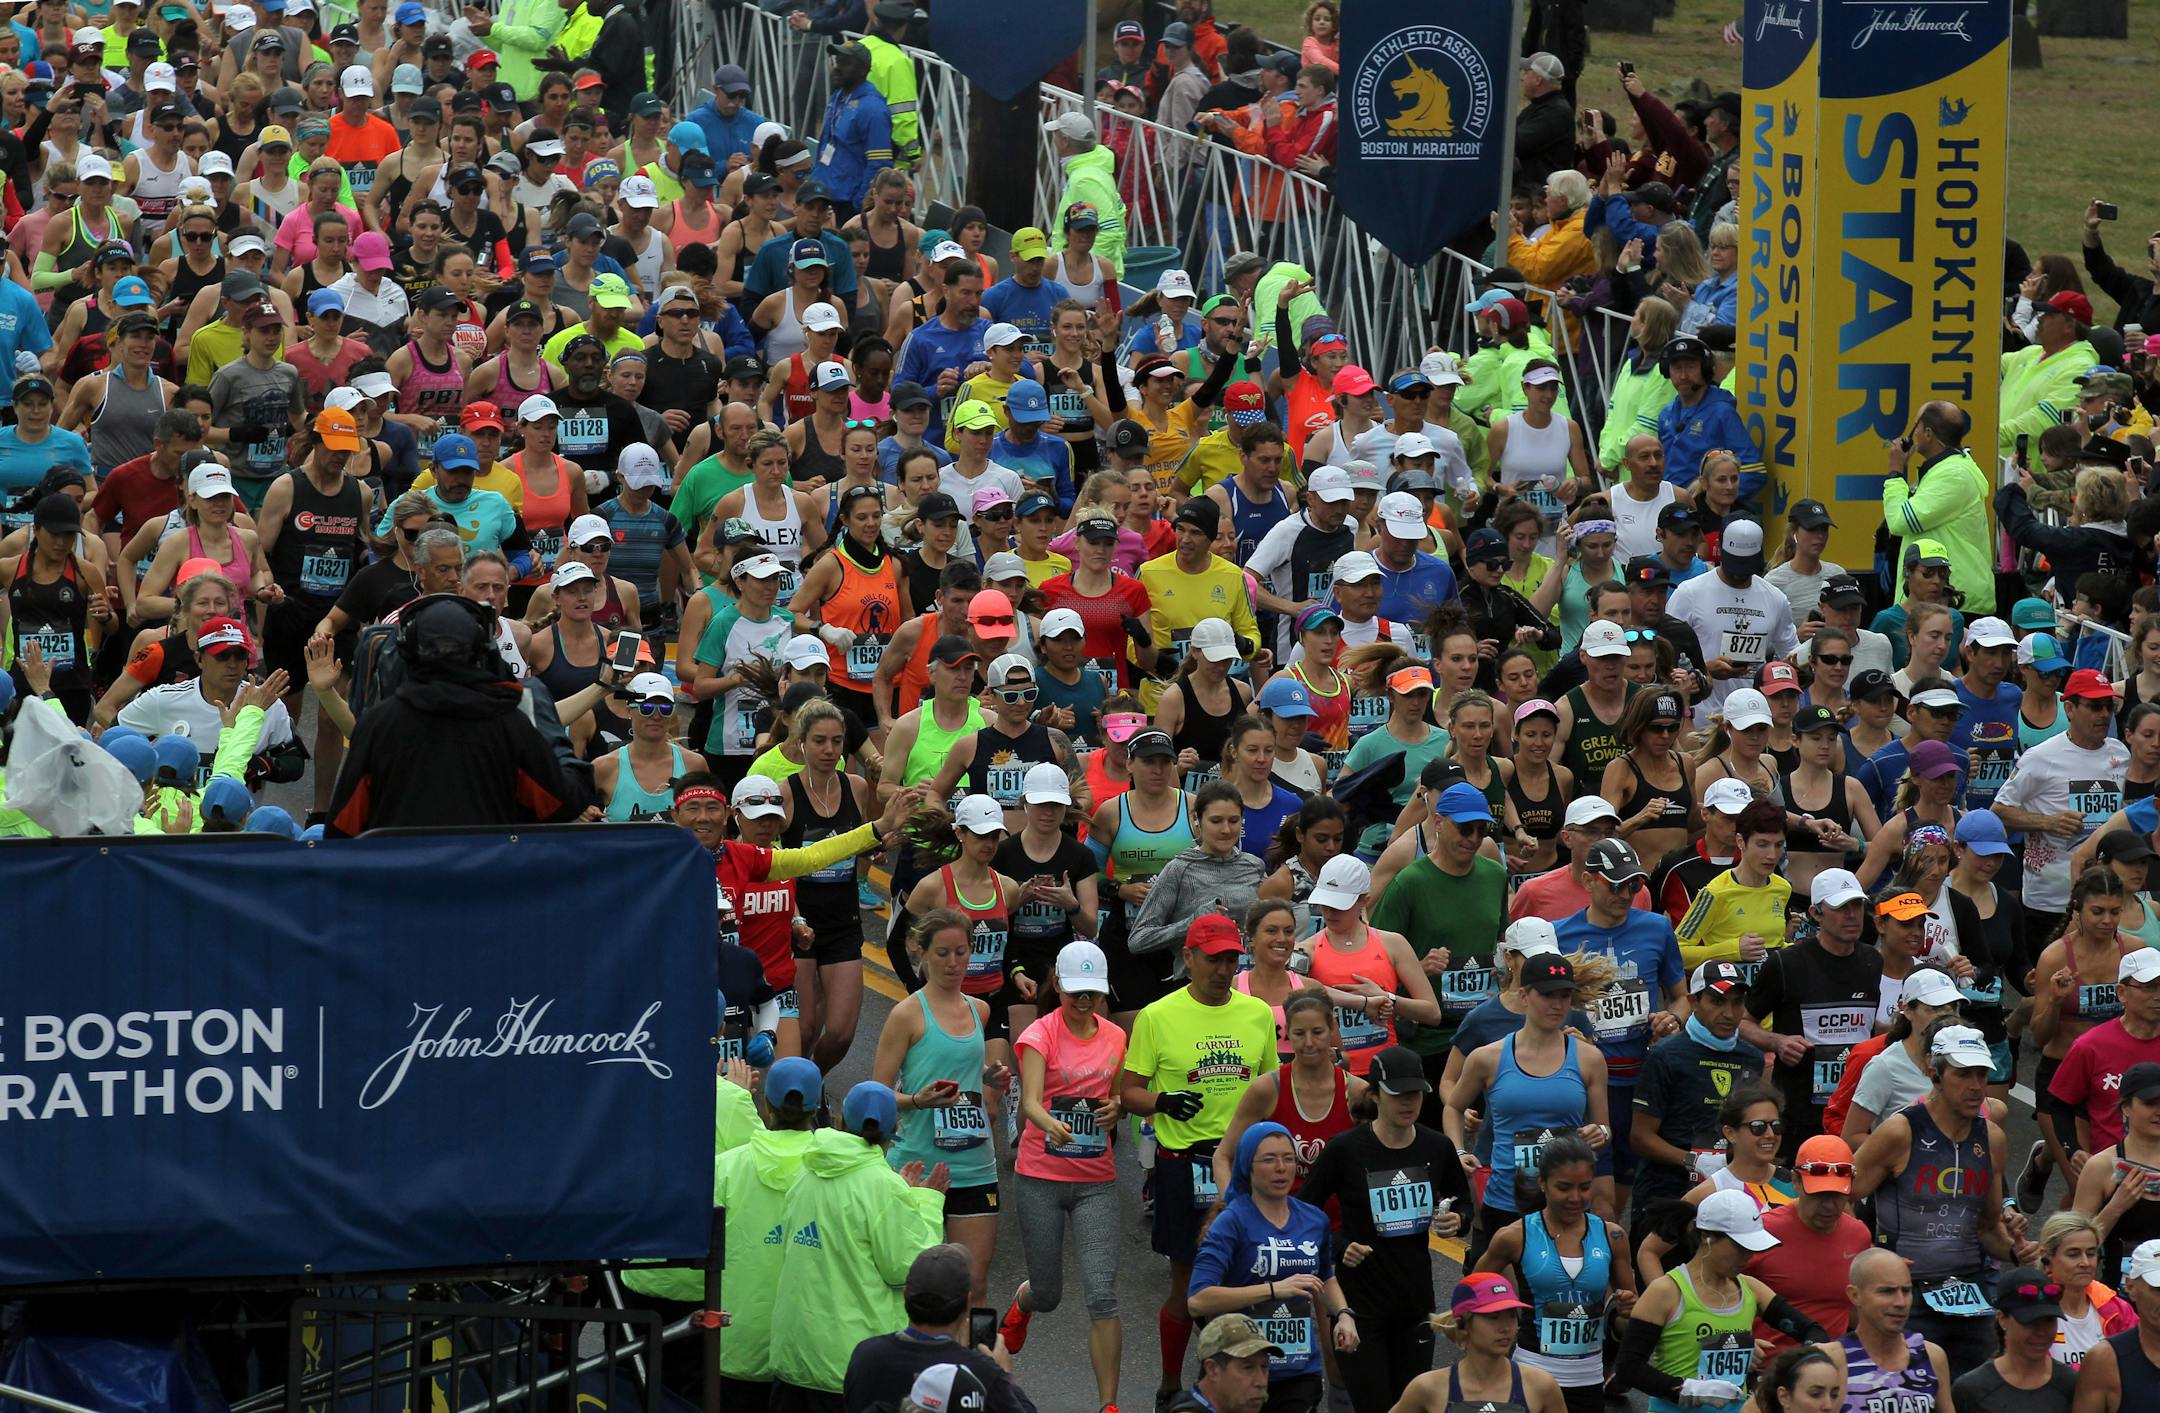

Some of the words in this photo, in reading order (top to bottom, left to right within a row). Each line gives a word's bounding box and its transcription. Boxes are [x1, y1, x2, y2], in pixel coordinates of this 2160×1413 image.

[1851, 8, 1901, 50] John
[1899, 7, 1972, 42] Hancock
[1357, 66, 1378, 129] BOSTON
[1372, 31, 1442, 67] ATHLETIC
[1442, 35, 1488, 129] ASSOCIATION
[1361, 142, 1408, 155] BOSTON
[1412, 142, 1480, 155] MARATHON
[1931, 138, 1980, 437] HOPKINT
[1746, 104, 1774, 515] MARATHO
[1774, 153, 1803, 467] BOSTON
[456, 332, 484, 345] NINJA
[1054, 394, 1088, 411] 1613
[562, 419, 605, 441] 16128
[309, 557, 349, 578] 16321
[861, 593, 878, 606] BULL
[879, 595, 893, 606] CITY
[1729, 635, 1761, 654] 8727
[1581, 735, 1616, 751] GREA
[2077, 794, 2118, 813] 16345
[1522, 809, 1553, 819] GREATER
[1120, 849, 1157, 862] major
[744, 889, 790, 916] BURN
[1448, 970, 1491, 991] 16377
[1818, 1013, 1866, 1033] CCPUL
[25, 1007, 283, 1062] BOSTON
[359, 1002, 482, 1109] John
[480, 994, 673, 1079] Hancock
[1196, 1040, 1244, 1051] CARMEL
[1198, 1065, 1242, 1077] MARATHON
[1914, 1166, 1989, 1196] RCM
[1375, 1183, 1428, 1213] 16112
[793, 1235, 822, 1249] adidas
[1276, 1237, 1294, 1248] LIFE
[1279, 1256, 1316, 1272] Runners
[1930, 1284, 1980, 1307] 16220
[1549, 1319, 1598, 1346] 16182
[1706, 1351, 1751, 1377] 16457
[960, 1392, 984, 1410] ally
